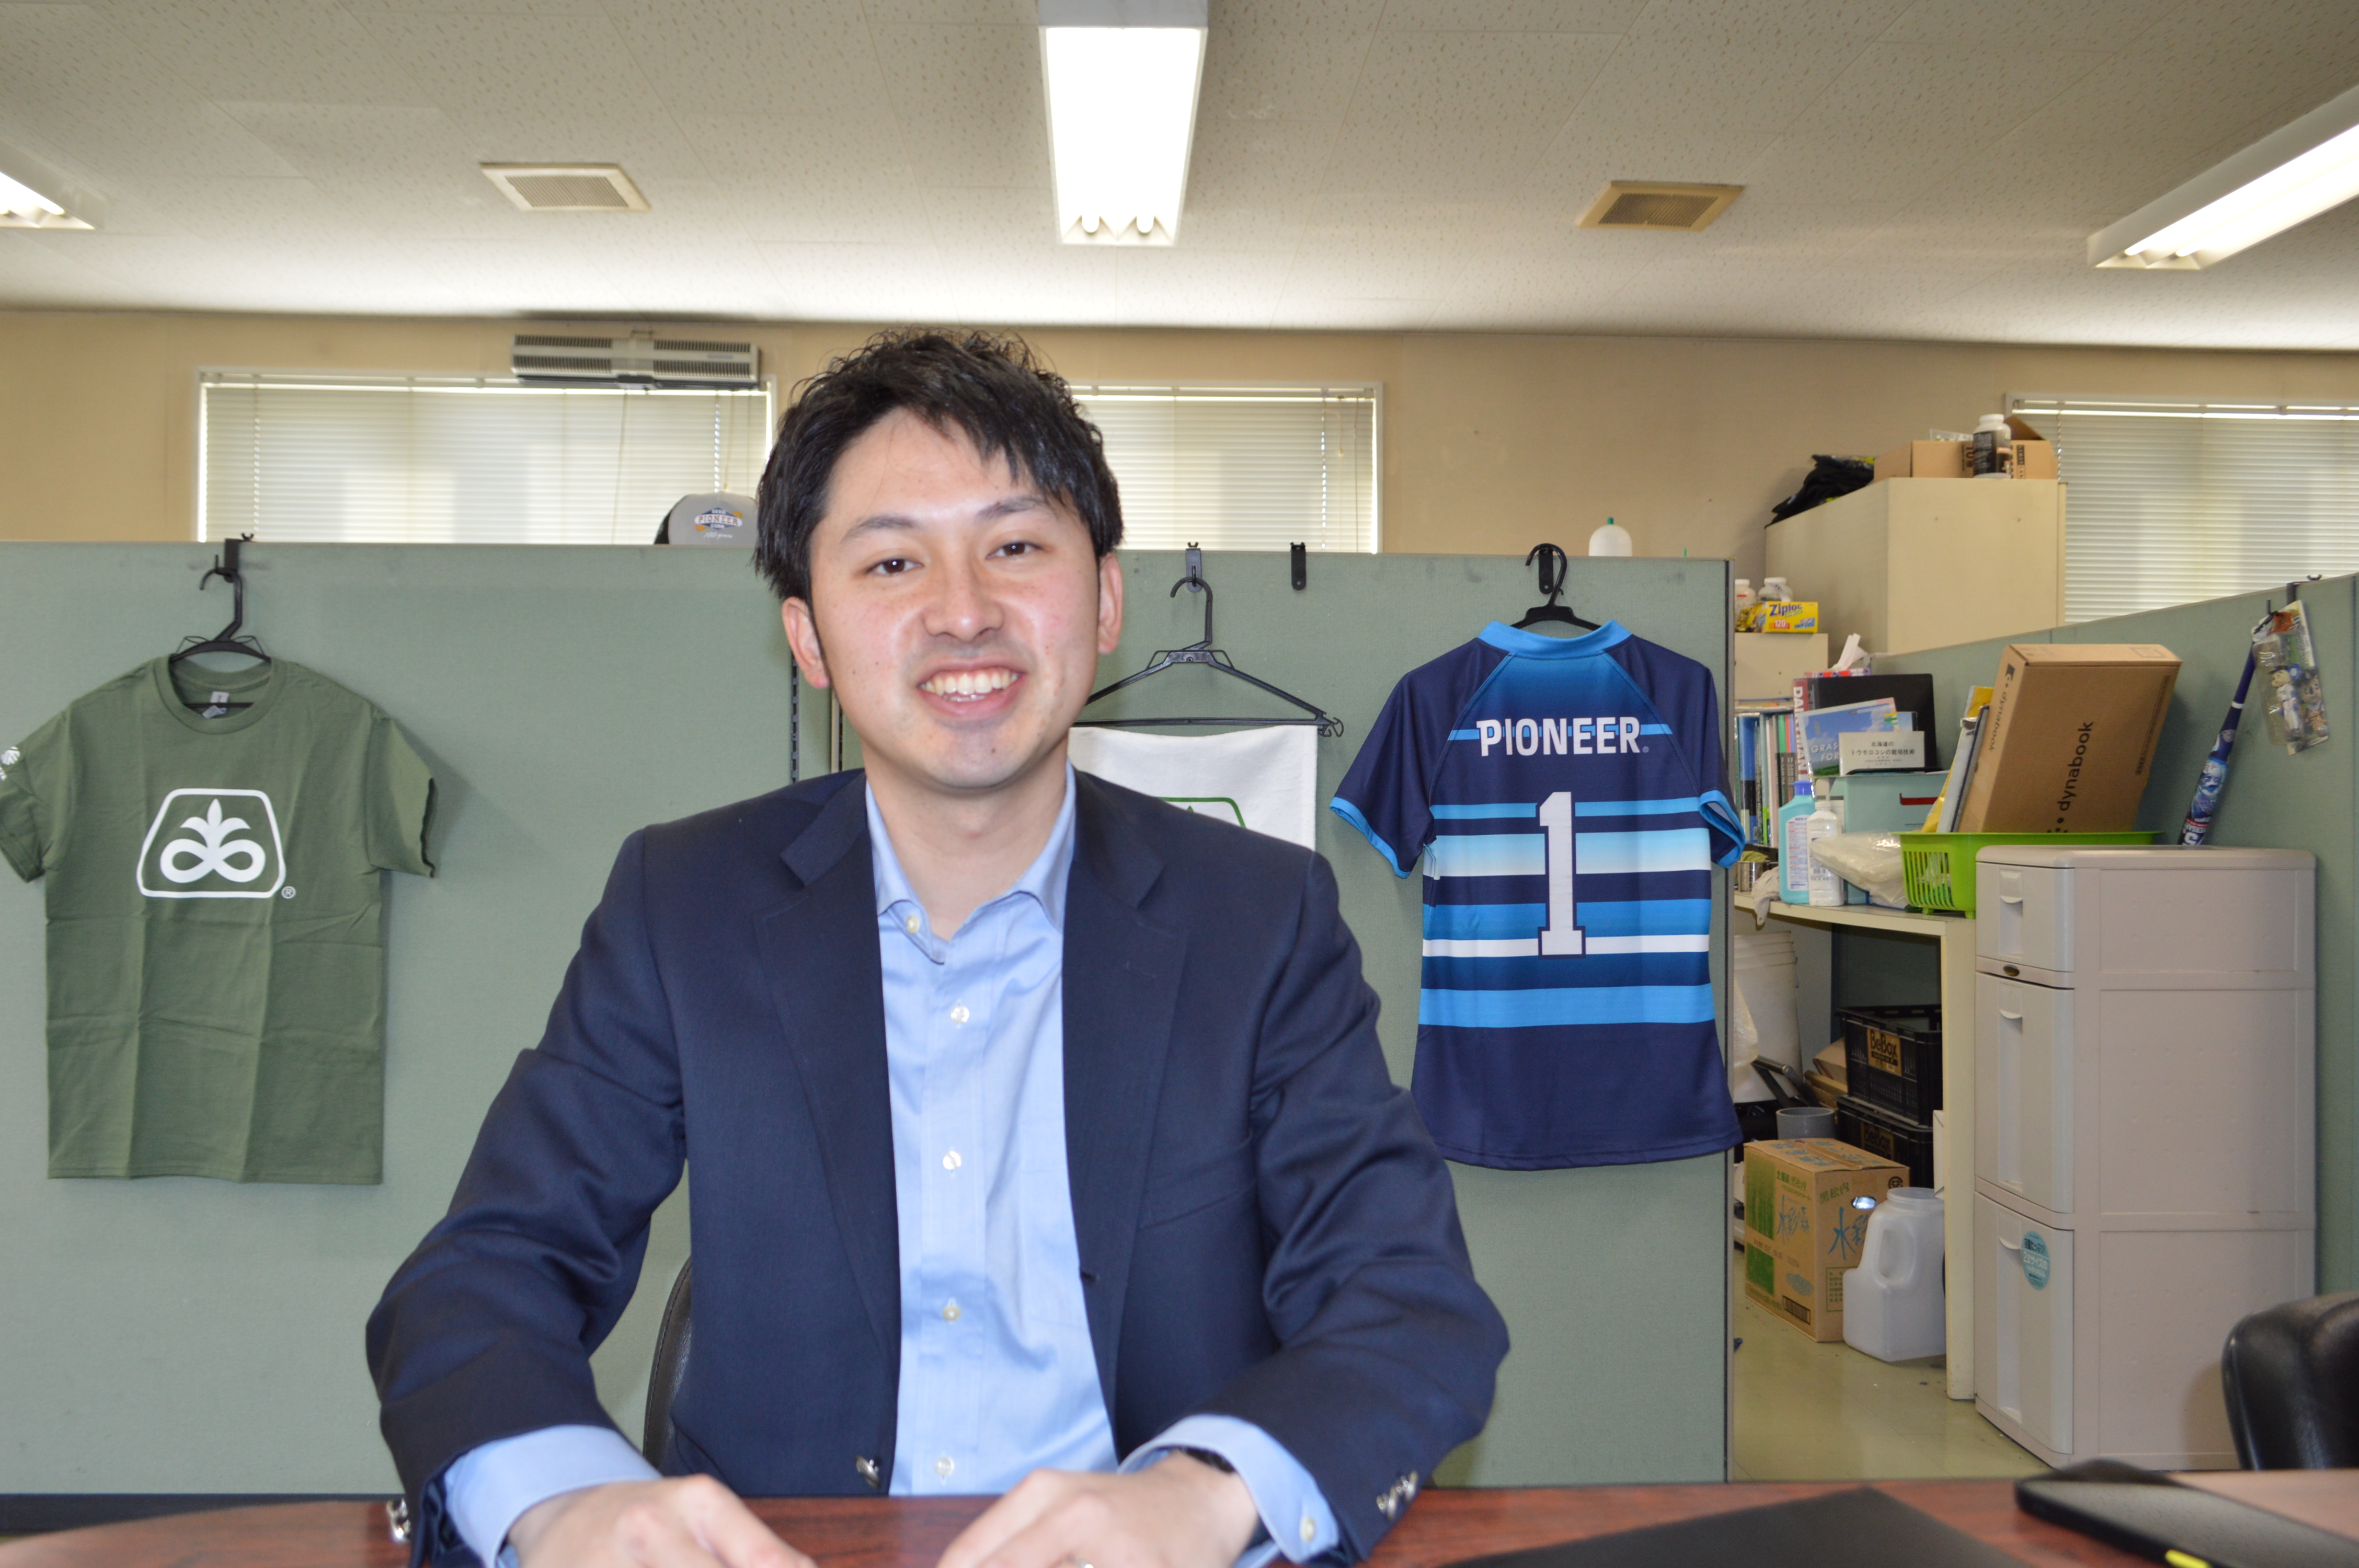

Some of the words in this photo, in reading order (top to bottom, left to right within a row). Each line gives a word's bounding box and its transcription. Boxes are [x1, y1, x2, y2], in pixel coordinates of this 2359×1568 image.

[698, 515, 738, 525] PIONEER
[1769, 603, 1802, 617] Ziploc
[1476, 717, 1640, 757] PIONEER
[1988, 691, 2008, 753] dynabook
[2057, 721, 2094, 812] dynabook
[1539, 791, 1583, 955] 1
[1870, 1030, 1898, 1058] BeBox
